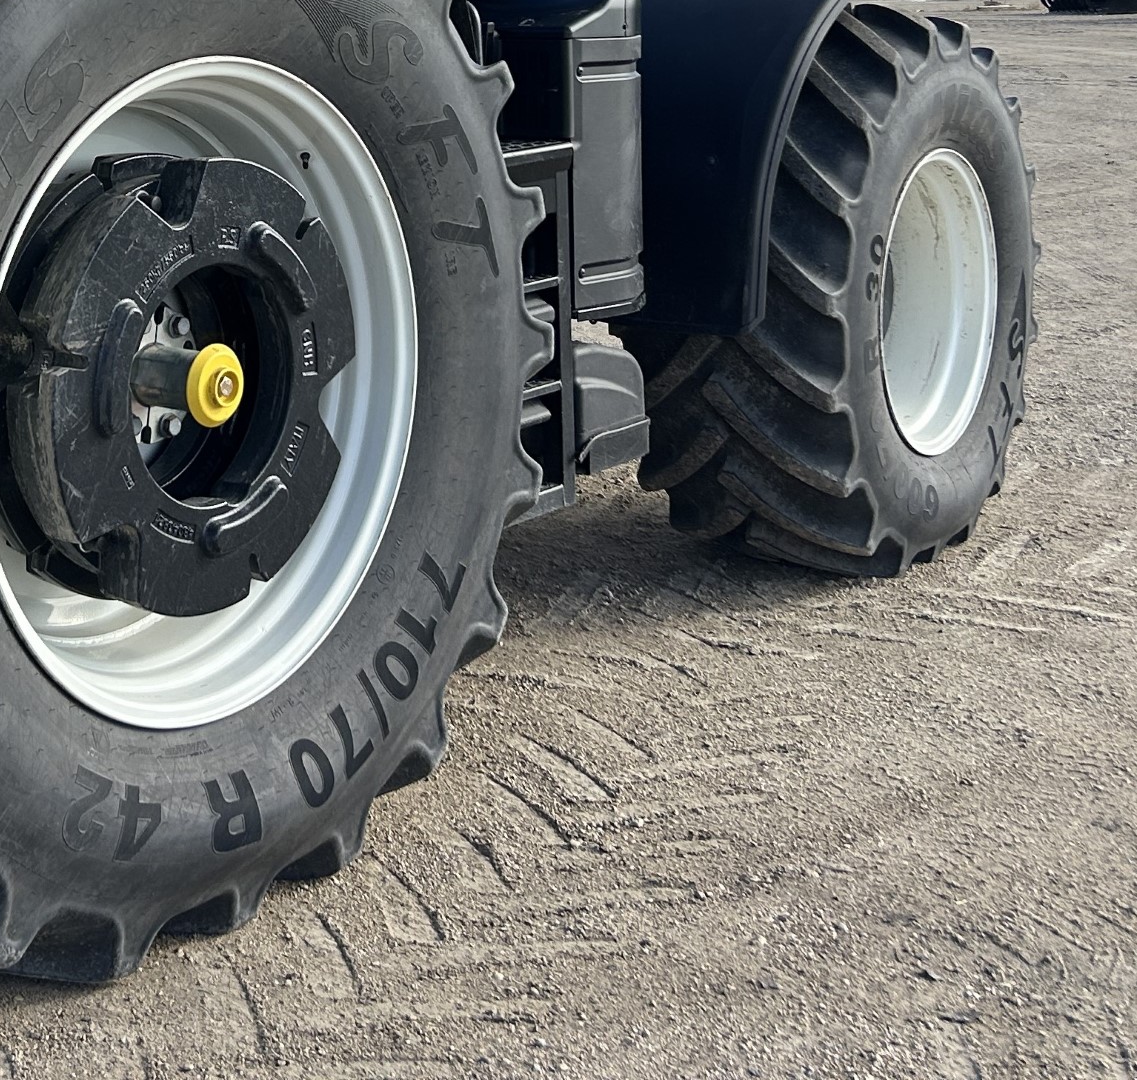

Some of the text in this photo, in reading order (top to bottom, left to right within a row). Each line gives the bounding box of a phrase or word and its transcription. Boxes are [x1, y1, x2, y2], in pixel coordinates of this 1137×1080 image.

[865, 234, 884, 302] 30
[63, 550, 466, 862] 710/70 R 42
